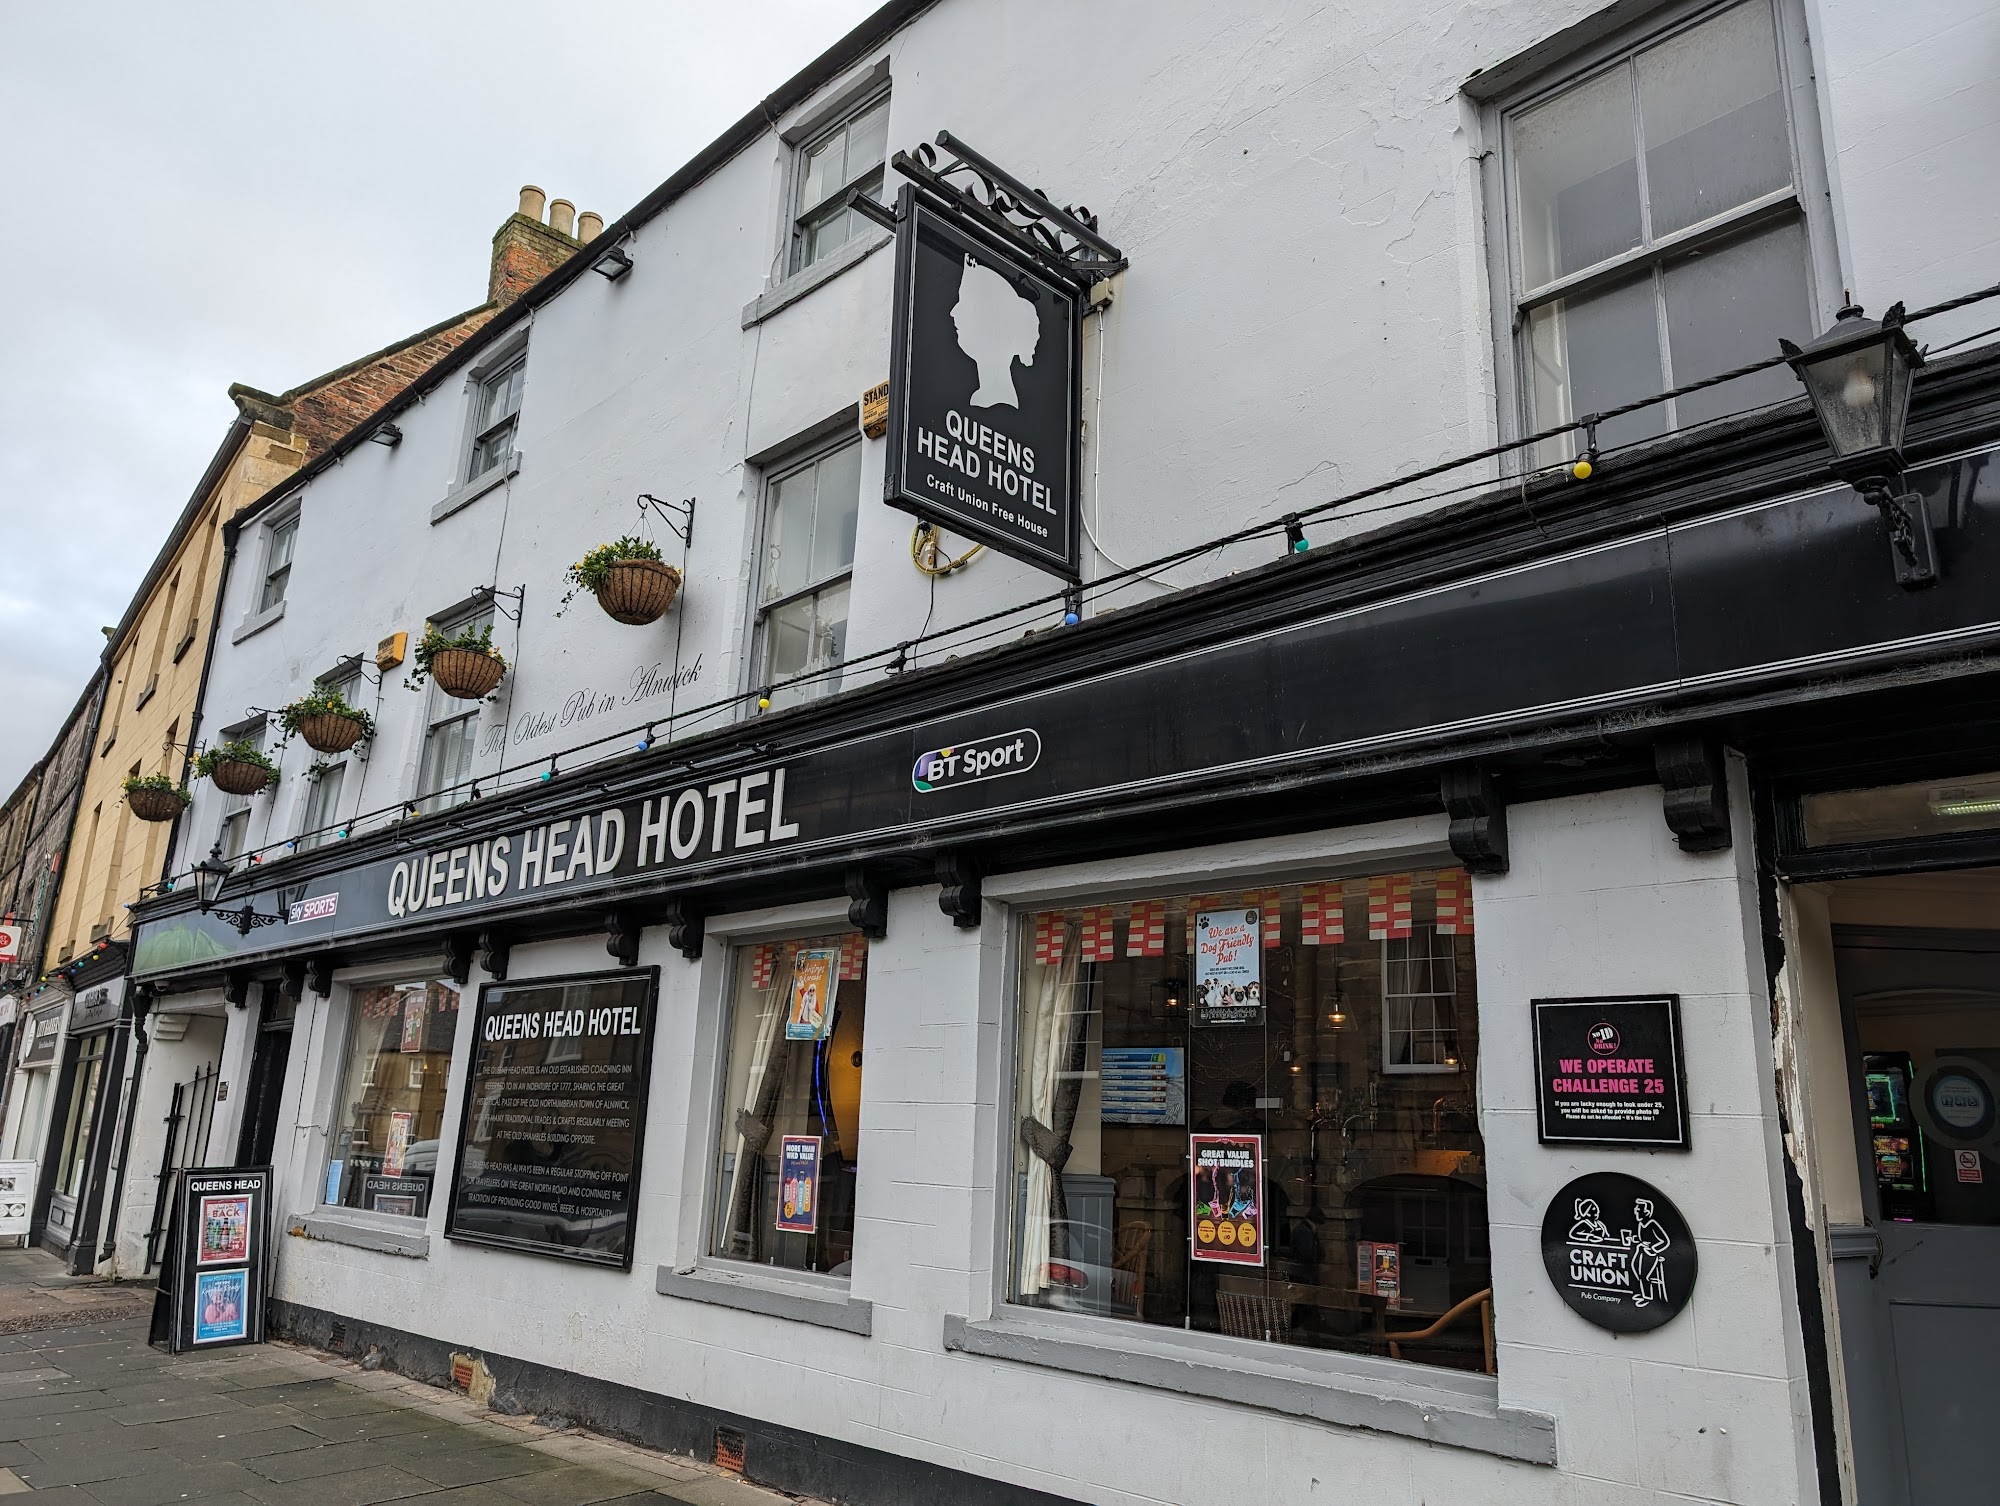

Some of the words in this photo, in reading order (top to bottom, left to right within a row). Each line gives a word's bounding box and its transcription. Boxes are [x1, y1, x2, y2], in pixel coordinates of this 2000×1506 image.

[946, 410, 1035, 474] QUEENS
[917, 426, 980, 478] HEAD
[988, 460, 1057, 516] HOTEL
[926, 474, 954, 498] Craft
[957, 486, 989, 512] Union
[991, 502, 1014, 523] Free
[1017, 511, 1049, 538] House
[480, 722, 507, 758] The
[512, 712, 558, 746] Oldest
[560, 687, 598, 728] Pub
[598, 695, 616, 715] in
[622, 653, 703, 706] Alnwick
[927, 754, 961, 782] BT
[962, 738, 1024, 776] Sport
[387, 835, 512, 918] QUEENS
[518, 806, 626, 890] HEAD
[636, 768, 800, 868] HOTEL
[290, 904, 304, 920] sky
[303, 897, 336, 918] SPORTS
[1208, 926, 1223, 940] We
[1224, 926, 1238, 936] are
[1240, 924, 1246, 932] a
[1200, 942, 1217, 954] Dog
[1218, 933, 1254, 952] Friendly
[1216, 949, 1238, 966] Pub!
[485, 1012, 540, 1042] QUEENS
[543, 1010, 584, 1038] HEAD
[588, 1006, 642, 1036] HOTEL
[1600, 1027, 1614, 1040] ID
[508, 1066, 520, 1074] HEAD
[521, 1066, 535, 1074] HOTEL
[536, 1066, 540, 1074] IS
[541, 1066, 548, 1074] AN
[549, 1066, 559, 1074] OLD
[560, 1065, 589, 1074] ESTABLISHED
[590, 1065, 621, 1073] COACHING
[622, 1065, 632, 1073] INN
[1560, 1059, 1582, 1073] WE
[1587, 1059, 1654, 1073] OPERATE
[506, 1082, 512, 1090] TO
[513, 1082, 519, 1090] IN
[519, 1082, 525, 1090] AN
[552, 1082, 559, 1090] OF
[560, 1082, 572, 1091] 1777,
[573, 1082, 595, 1091] SHARING
[596, 1082, 606, 1091] THE
[607, 1082, 624, 1091] GREAT
[1552, 1078, 1639, 1093] CHALLENGE
[1644, 1079, 1664, 1094] 25
[529, 1099, 539, 1107] OLD
[579, 1100, 595, 1108] TOWN
[596, 1100, 603, 1108] OF
[604, 1100, 629, 1110] ALNWICK,
[505, 1114, 533, 1123] TRADITIONAL
[534, 1116, 552, 1124] TRADES
[558, 1117, 575, 1125] CRAFTS
[576, 1117, 606, 1126] REGULARLY
[606, 1118, 629, 1128] MEETING
[503, 1131, 511, 1139] THE
[512, 1132, 522, 1140] OLD
[522, 1132, 546, 1142] SHAMBLES
[802, 1145, 815, 1153] THAN
[1201, 1150, 1225, 1158] GREAT
[1227, 1150, 1250, 1159] VALUE
[1198, 1158, 1218, 1167] SHOT
[1219, 1159, 1254, 1168] BUNDLES
[490, 1162, 502, 1170] HEAD
[503, 1163, 512, 1171] HAS
[513, 1164, 532, 1173] ALWAYS
[533, 1166, 545, 1174] BEEN
[545, 1167, 550, 1175] A
[550, 1167, 574, 1177] REGULAR
[574, 1169, 600, 1180] STOPPING
[601, 1172, 611, 1180] OFF
[612, 1173, 628, 1182] POINT
[191, 1180, 232, 1192] QUEENS
[234, 1180, 261, 1190] HEAD
[501, 1180, 509, 1188] ON
[510, 1180, 518, 1189] THE
[518, 1181, 534, 1191] GREAT
[534, 1183, 551, 1193] NORTH
[552, 1185, 567, 1195] ROAD
[568, 1187, 580, 1196] AND
[581, 1188, 610, 1199] CONTINUES
[612, 1191, 622, 1200] THE
[212, 1207, 240, 1218] BACK
[491, 1196, 498, 1204] OF
[498, 1196, 524, 1207] PROVIDING
[525, 1200, 541, 1209] GOOD
[542, 1202, 558, 1212] WINES,
[560, 1204, 574, 1214] BEERS
[575, 1206, 579, 1215] &
[1570, 1249, 1628, 1269] CRAFT
[1570, 1265, 1630, 1286] UNION
[1593, 1294, 1621, 1304] Company
